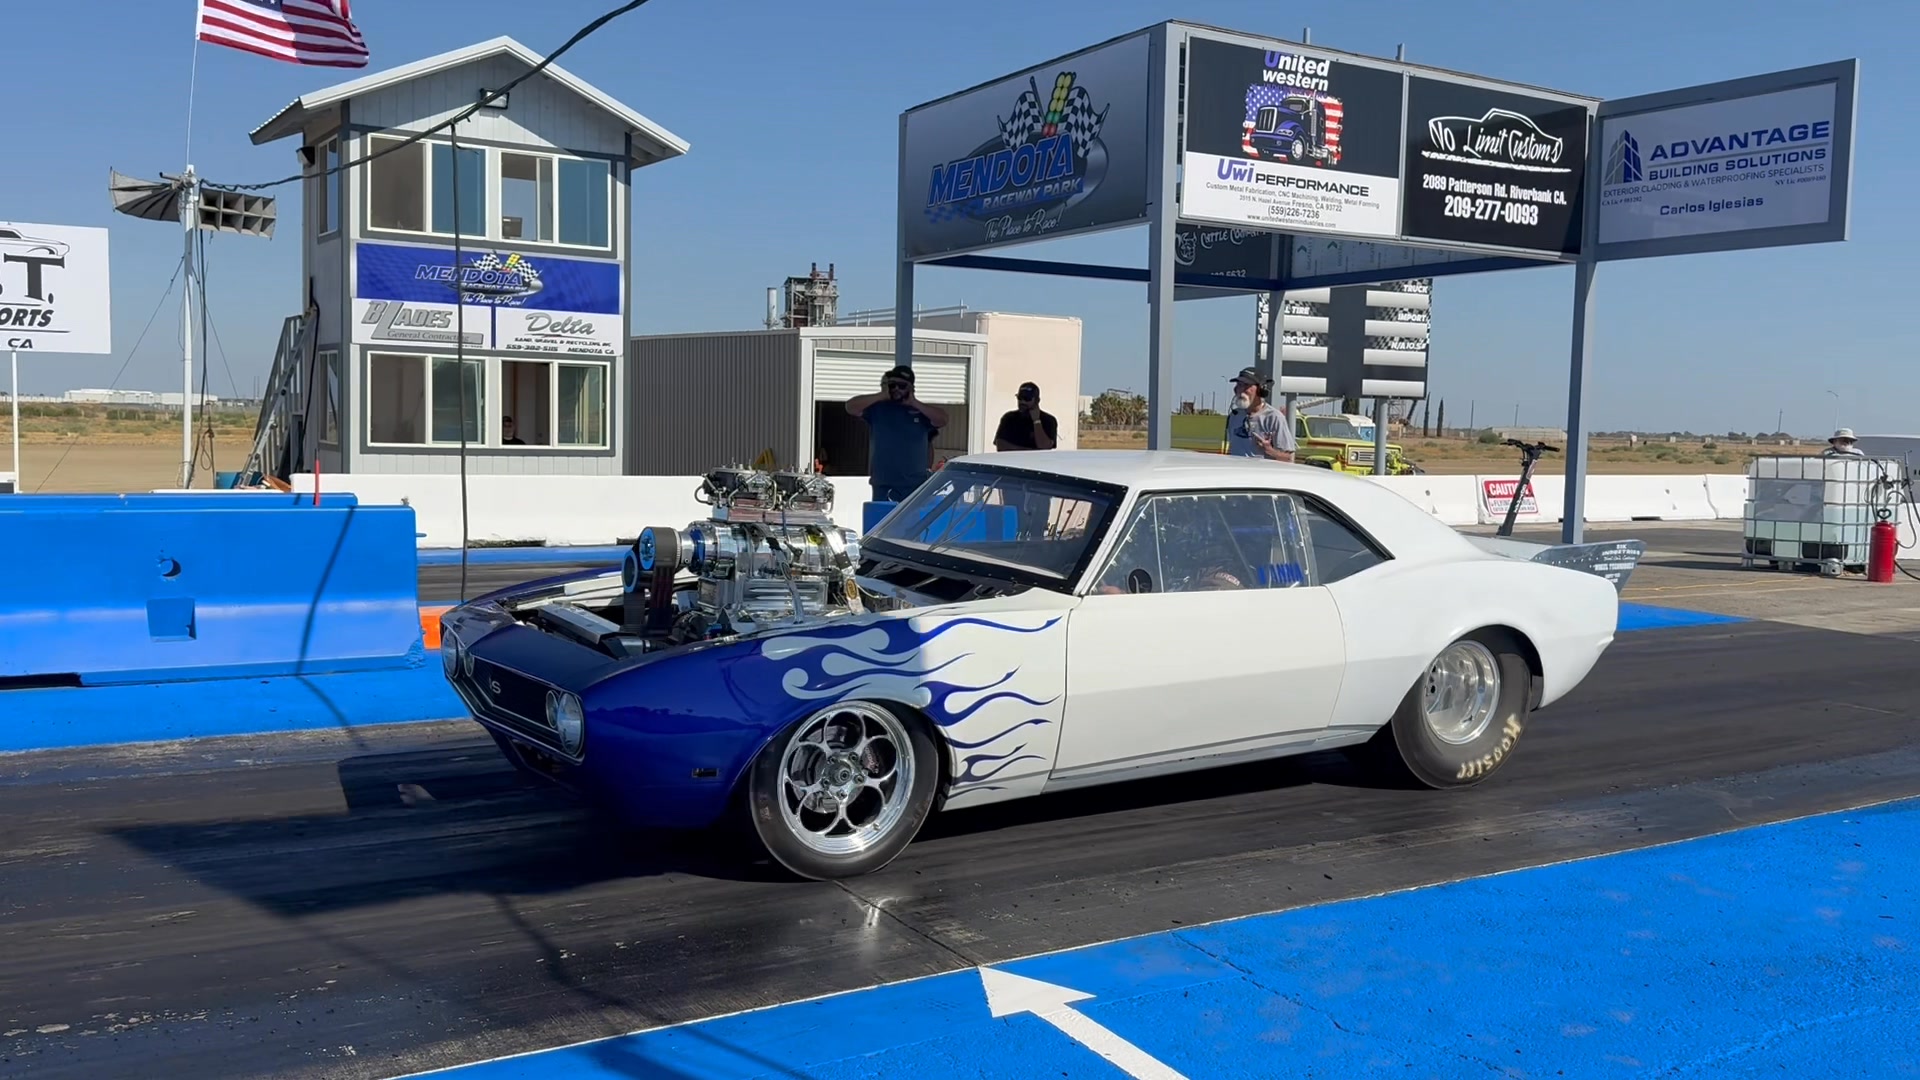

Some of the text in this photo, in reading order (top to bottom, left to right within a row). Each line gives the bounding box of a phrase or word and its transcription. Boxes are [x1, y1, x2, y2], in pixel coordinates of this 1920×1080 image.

[1264, 50, 1331, 77] United
[1263, 69, 1329, 91] western
[1463, 124, 1508, 158] Limit
[1508, 129, 1563, 163] Customs
[1649, 120, 1830, 162] ADVANTAGE
[927, 131, 1074, 208] MENDOTA
[1649, 148, 1827, 181] BUILDING SOLUTIONS
[1255, 173, 1370, 197] PERFORMANCE
[1423, 173, 1568, 205] 2089 Patterson Rd. Riverbank CA.
[1603, 163, 1825, 198] EXTERIOR CLADDING & WATERPROOFING SPECIALISTS
[982, 177, 1082, 209] RACEWAY PARK
[1206, 181, 1228, 191] Custom
[1229, 184, 1244, 193] Metal
[1278, 190, 1290, 198] CNC
[1359, 200, 1380, 209] Forming
[1268, 205, 1320, 219] (559)226-7236
[1315, 202, 1325, 210] CA
[1444, 195, 1539, 225] 209-277-0093
[1660, 196, 1764, 215] Carlos Iglesias
[985, 217, 1000, 241] The
[998, 214, 1021, 236] Place
[1200, 229, 1229, 249] CATTLE
[415, 264, 523, 286] MENDOTA
[1403, 285, 1428, 293] TRUCK
[361, 300, 453, 331] BLADES
[1291, 306, 1310, 314] TIRE
[1397, 313, 1426, 321] IMPORT
[387, 330, 420, 339] General
[525, 312, 596, 335] Delta
[8, 338, 33, 348] CA
